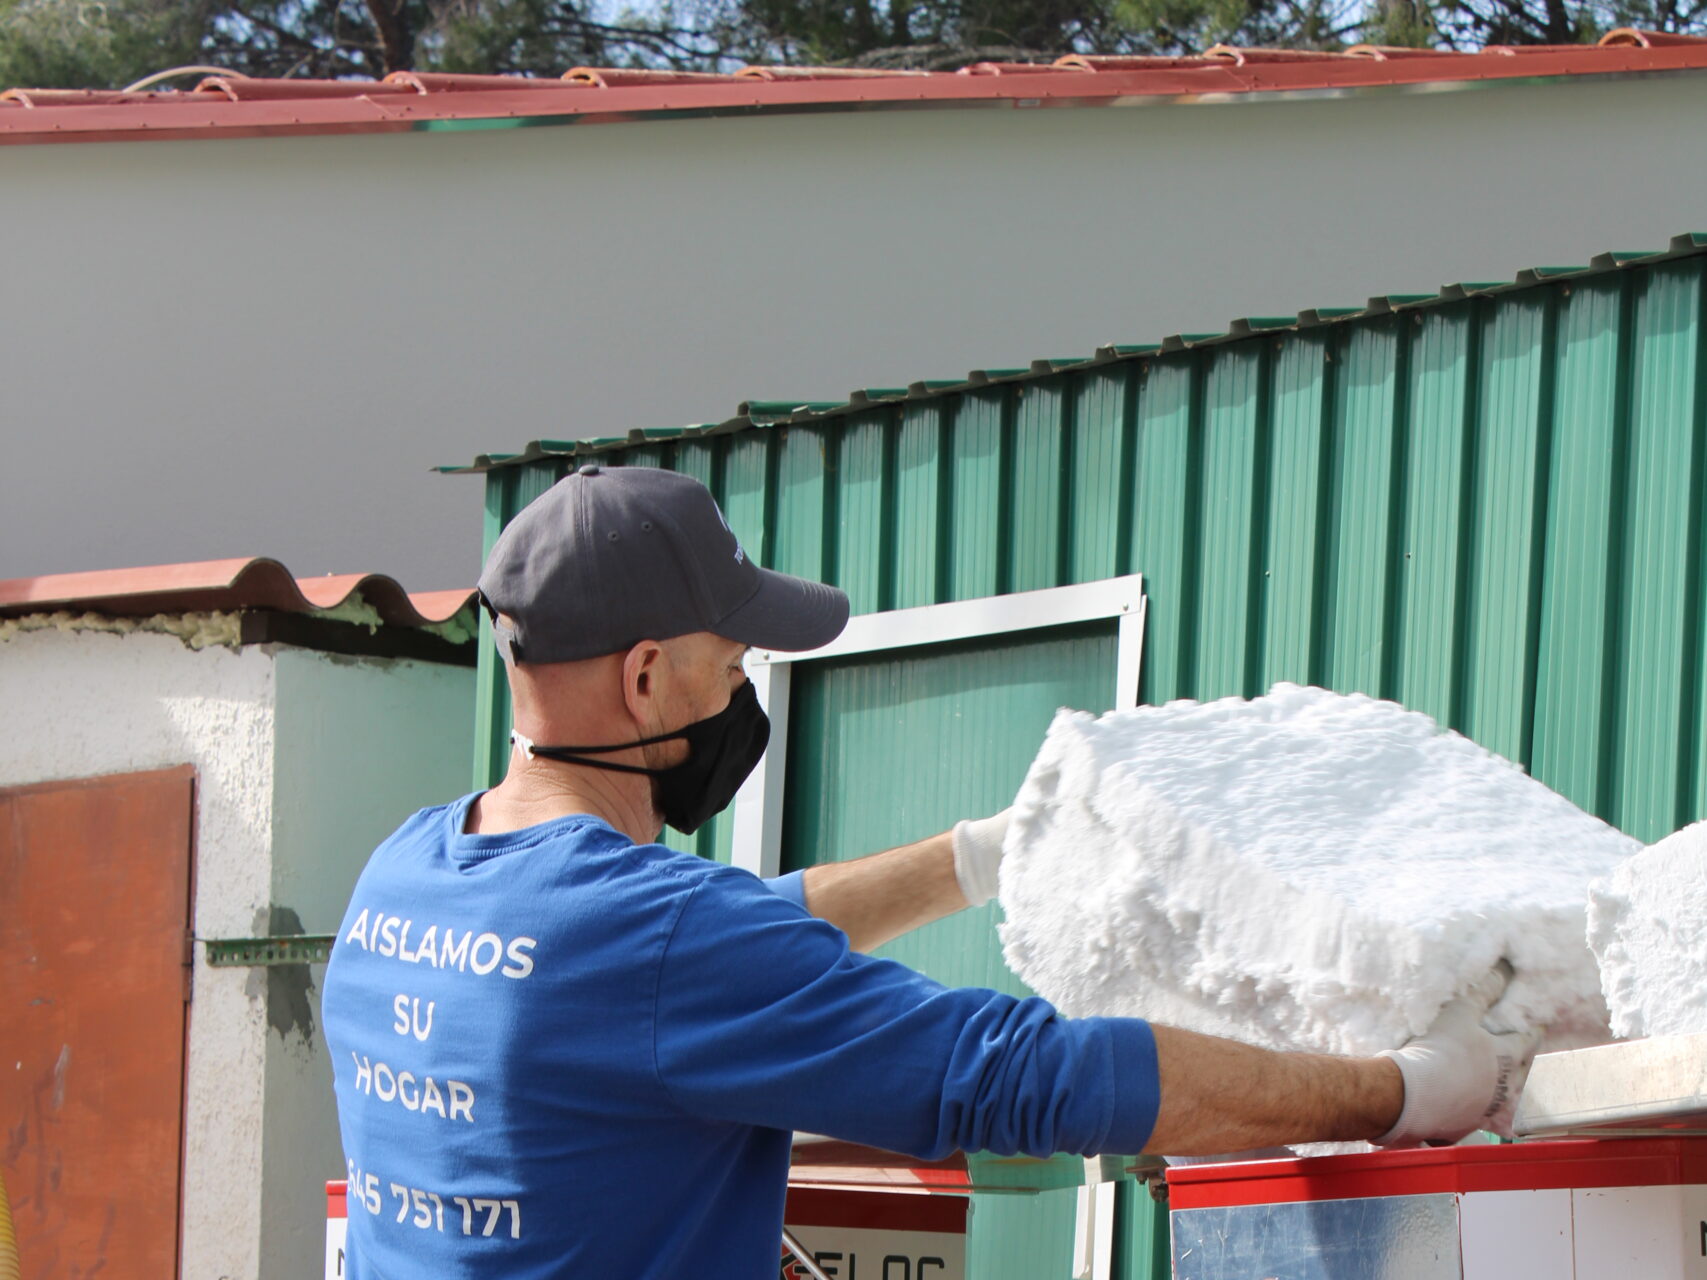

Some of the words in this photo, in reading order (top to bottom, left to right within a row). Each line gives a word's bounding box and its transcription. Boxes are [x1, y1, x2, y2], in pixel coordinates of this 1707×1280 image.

[346, 908, 537, 979] AISLAMOS
[393, 994, 435, 1041] SU
[352, 1052, 475, 1122] HOGAR
[390, 1182, 444, 1232] 751
[453, 1197, 521, 1239] 171
